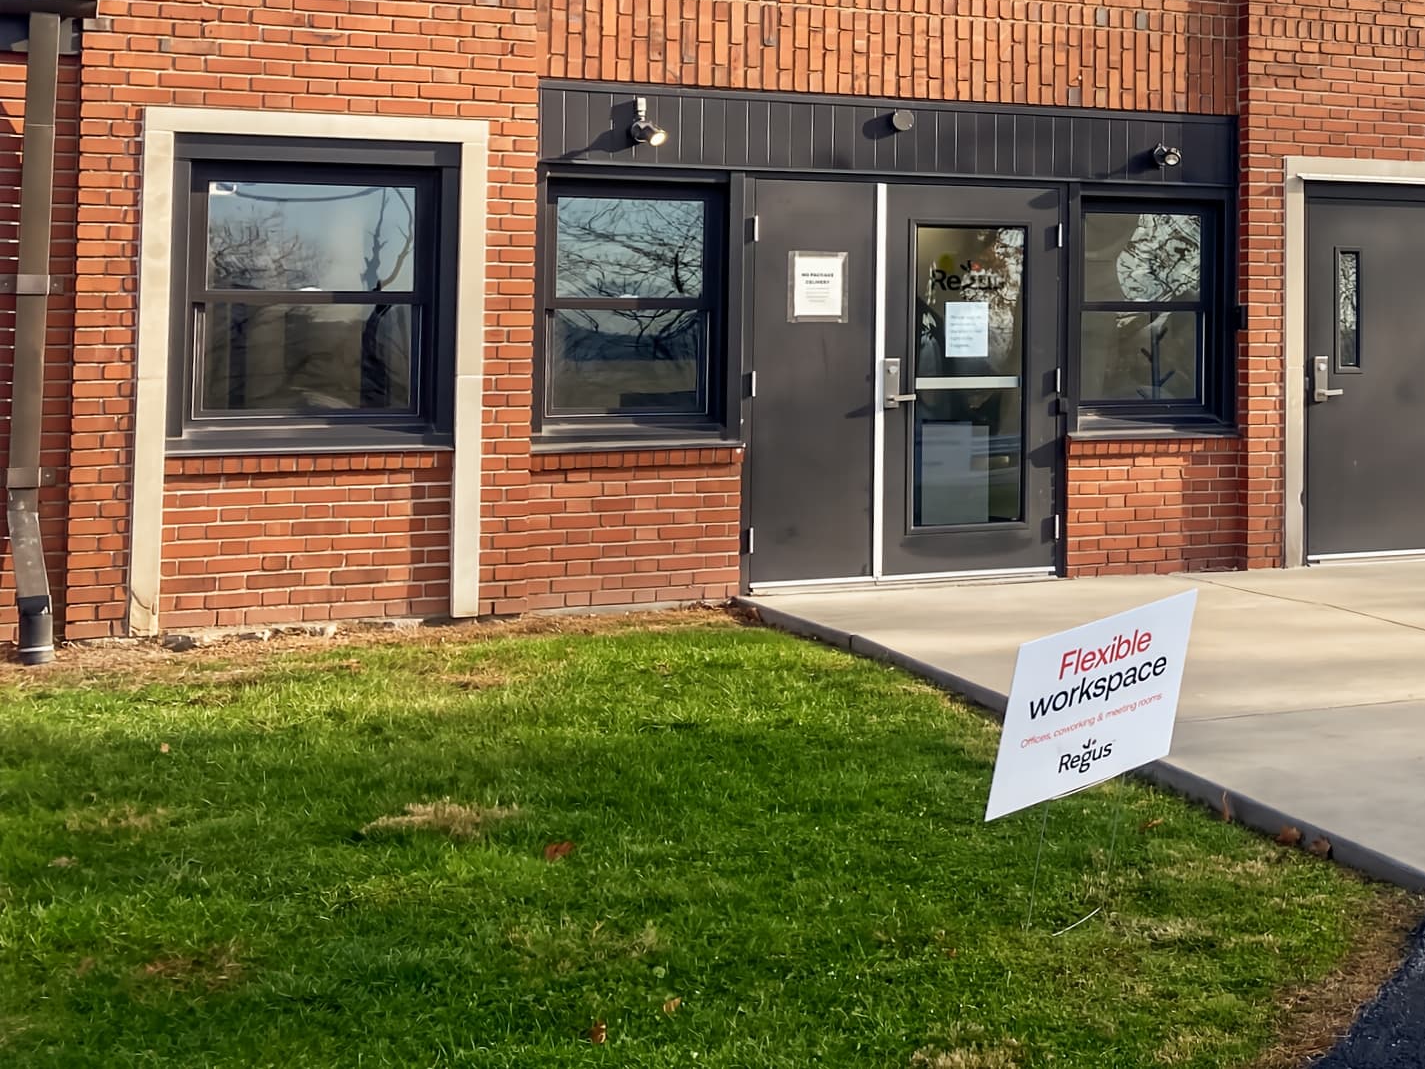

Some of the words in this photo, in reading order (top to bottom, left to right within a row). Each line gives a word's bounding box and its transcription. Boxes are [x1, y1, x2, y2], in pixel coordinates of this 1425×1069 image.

[1058, 629, 1152, 680] Flexible
[1029, 656, 1167, 720] workspace
[1053, 715, 1096, 739] coworking
[1096, 712, 1105, 723] &
[1105, 701, 1138, 719] meeting
[1138, 693, 1163, 707] rooms
[1058, 738, 1112, 773] Regus
